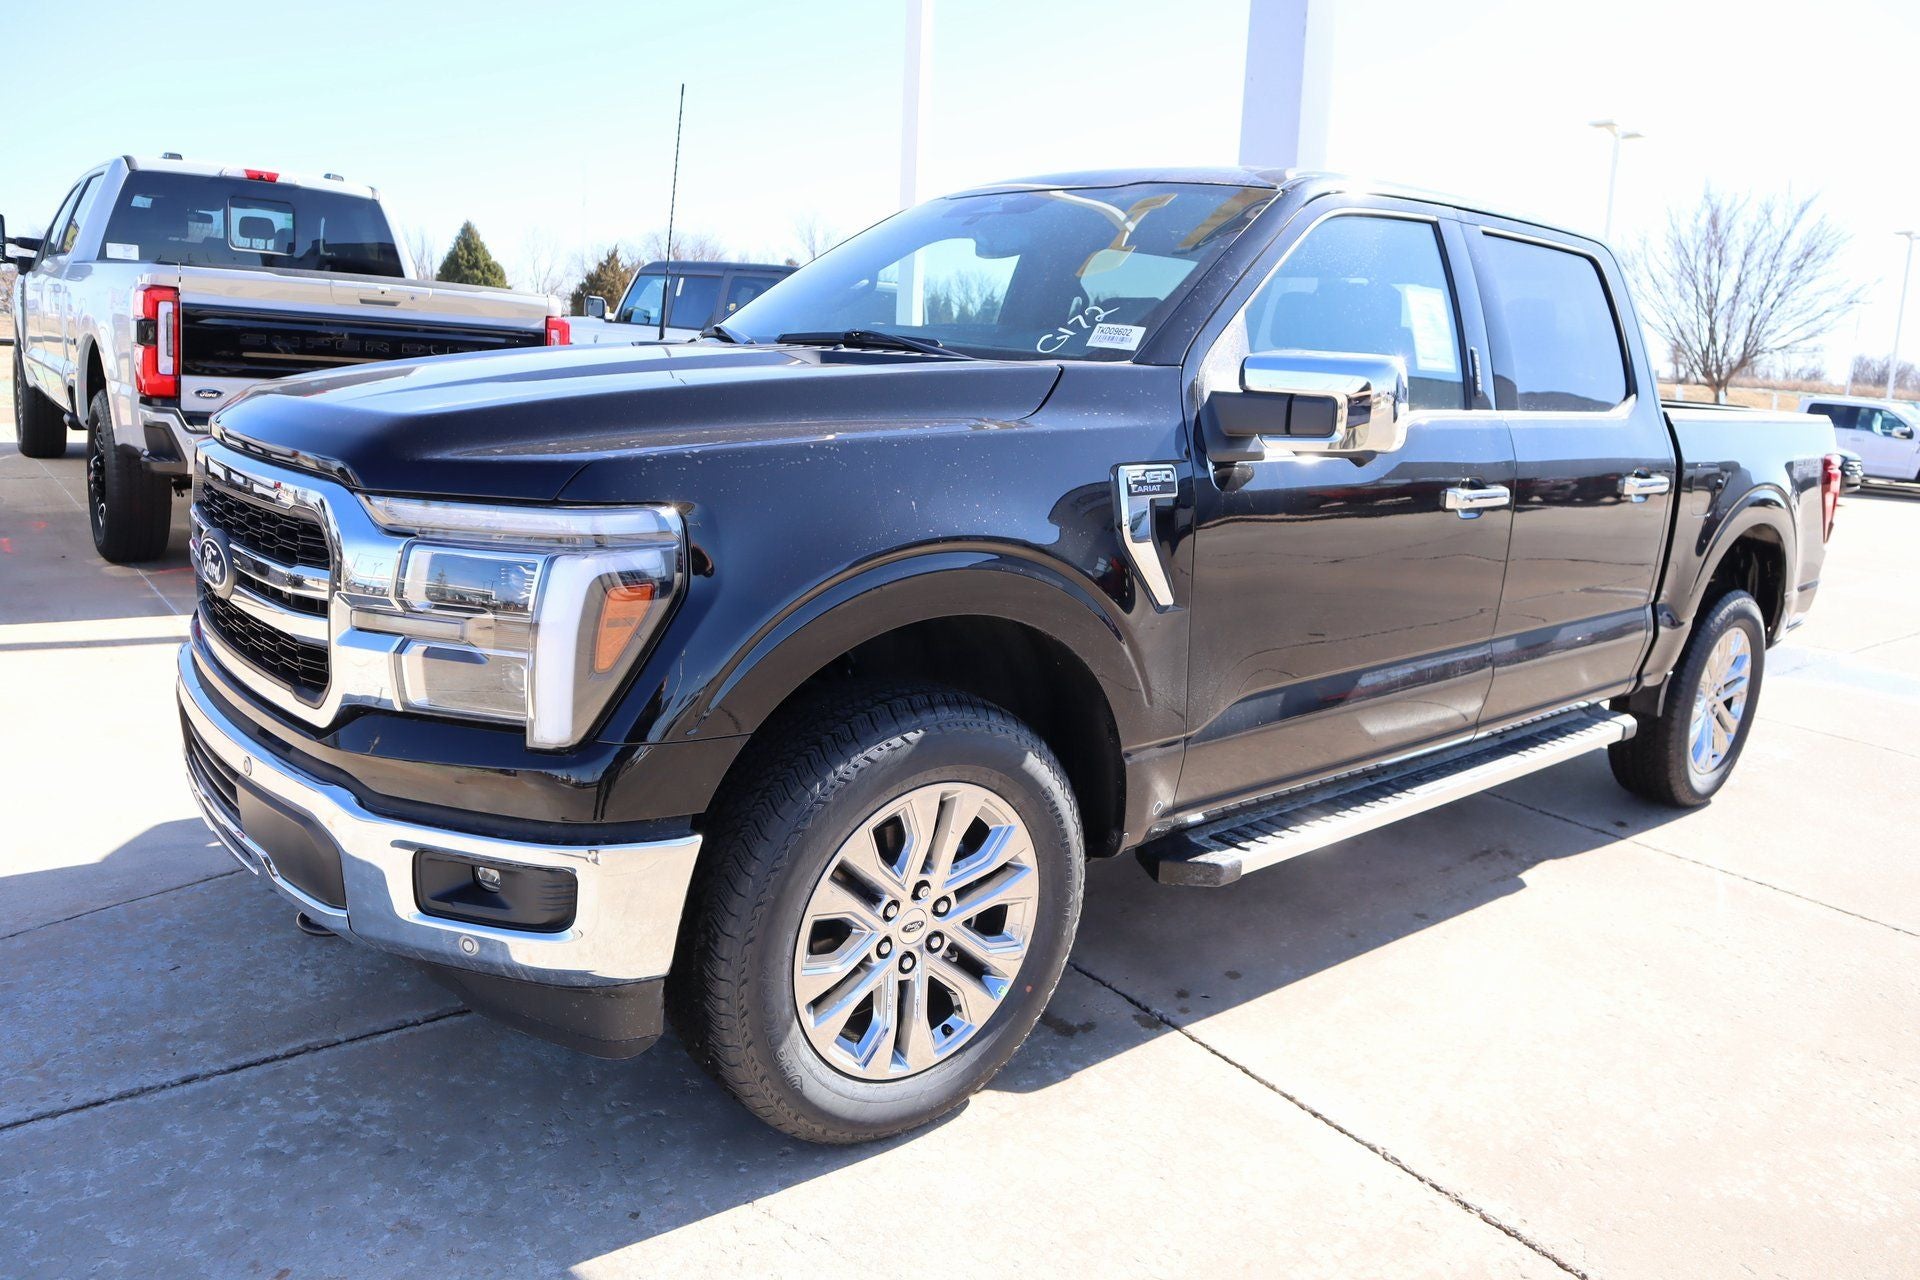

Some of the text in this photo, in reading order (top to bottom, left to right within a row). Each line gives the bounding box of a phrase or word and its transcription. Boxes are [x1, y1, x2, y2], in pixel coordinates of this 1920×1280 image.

[240, 333, 390, 353] SUPER
[1130, 484, 1161, 493] LARIAT
[203, 543, 221, 582] Ford
[760, 963, 797, 1083] Hankook
